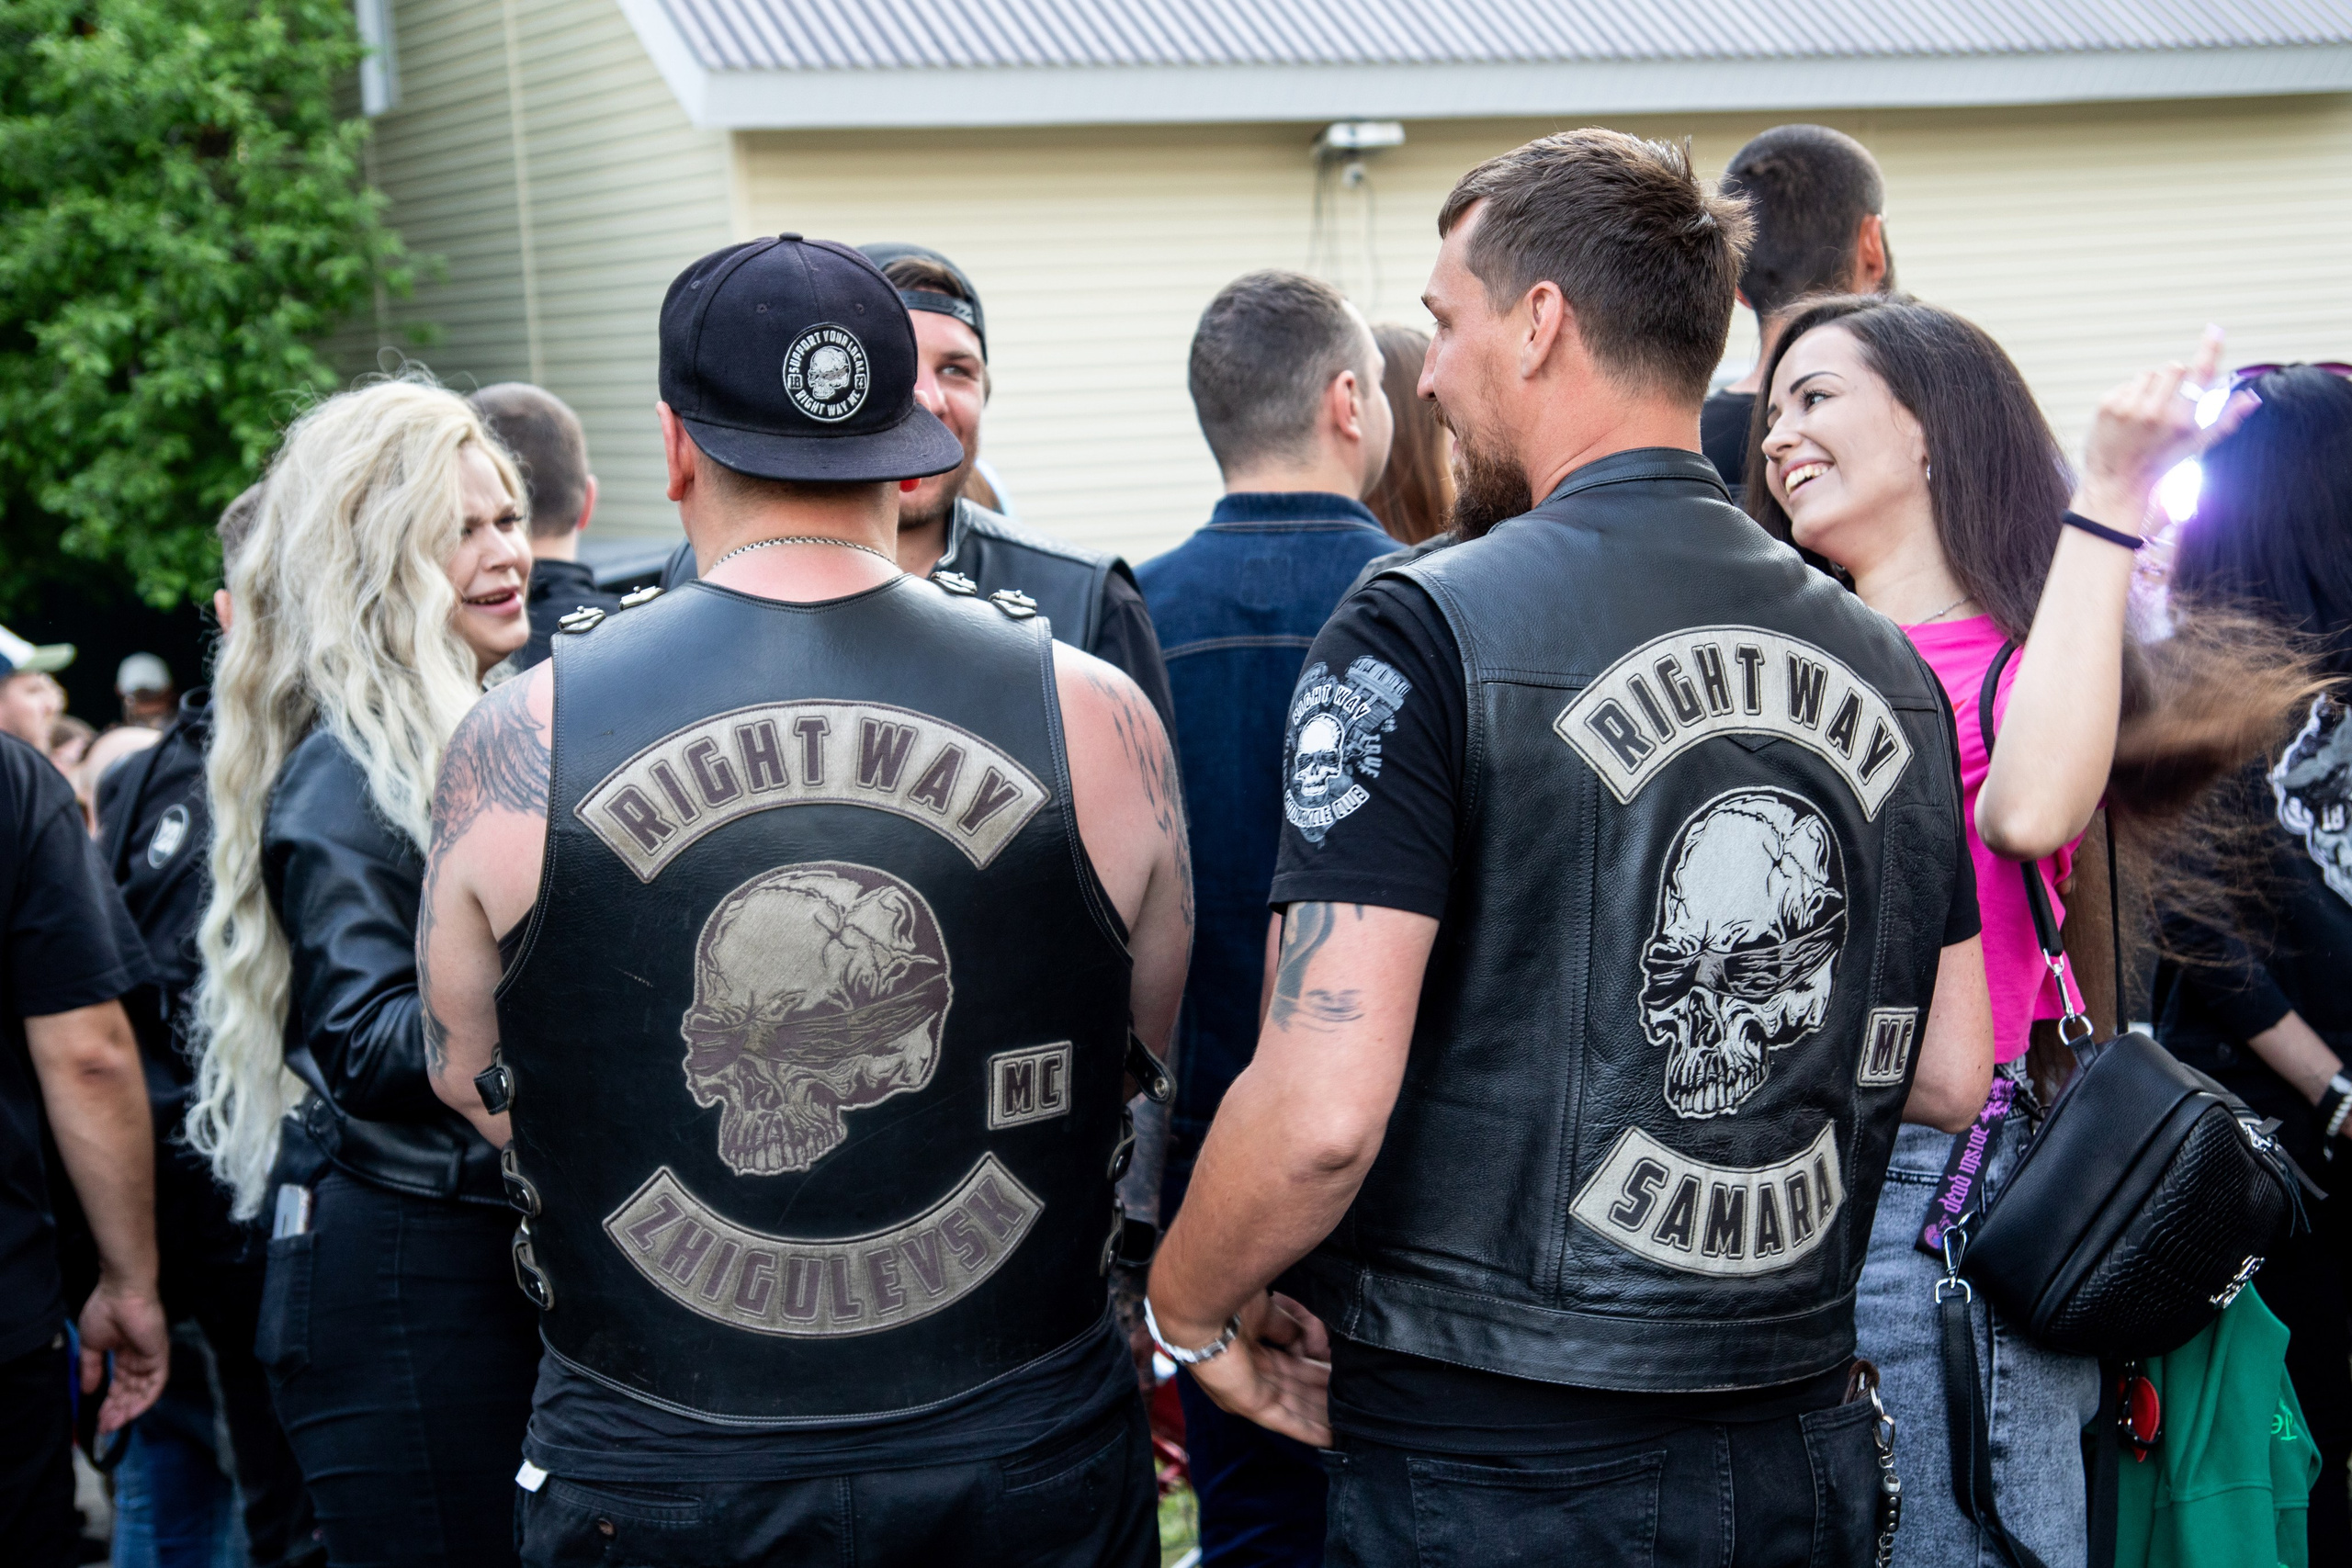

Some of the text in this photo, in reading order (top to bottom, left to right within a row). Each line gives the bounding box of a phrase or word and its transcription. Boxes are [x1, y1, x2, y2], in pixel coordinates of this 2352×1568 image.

[788, 330, 865, 373] SUPPORT YOUR LOCAL
[789, 376, 801, 387] 18
[795, 389, 826, 415] RIGHT
[827, 400, 848, 416] WAY
[1293, 683, 1372, 726] RIGHT WAY
[1583, 642, 1900, 785] RIGHT WAY
[603, 716, 1022, 857] RIGHT WAY
[1871, 1019, 1912, 1076] MC
[1001, 1055, 1062, 1118] MC
[1608, 1153, 1834, 1260] SAMARA
[625, 1175, 1027, 1325] ZHIGULEVSK
